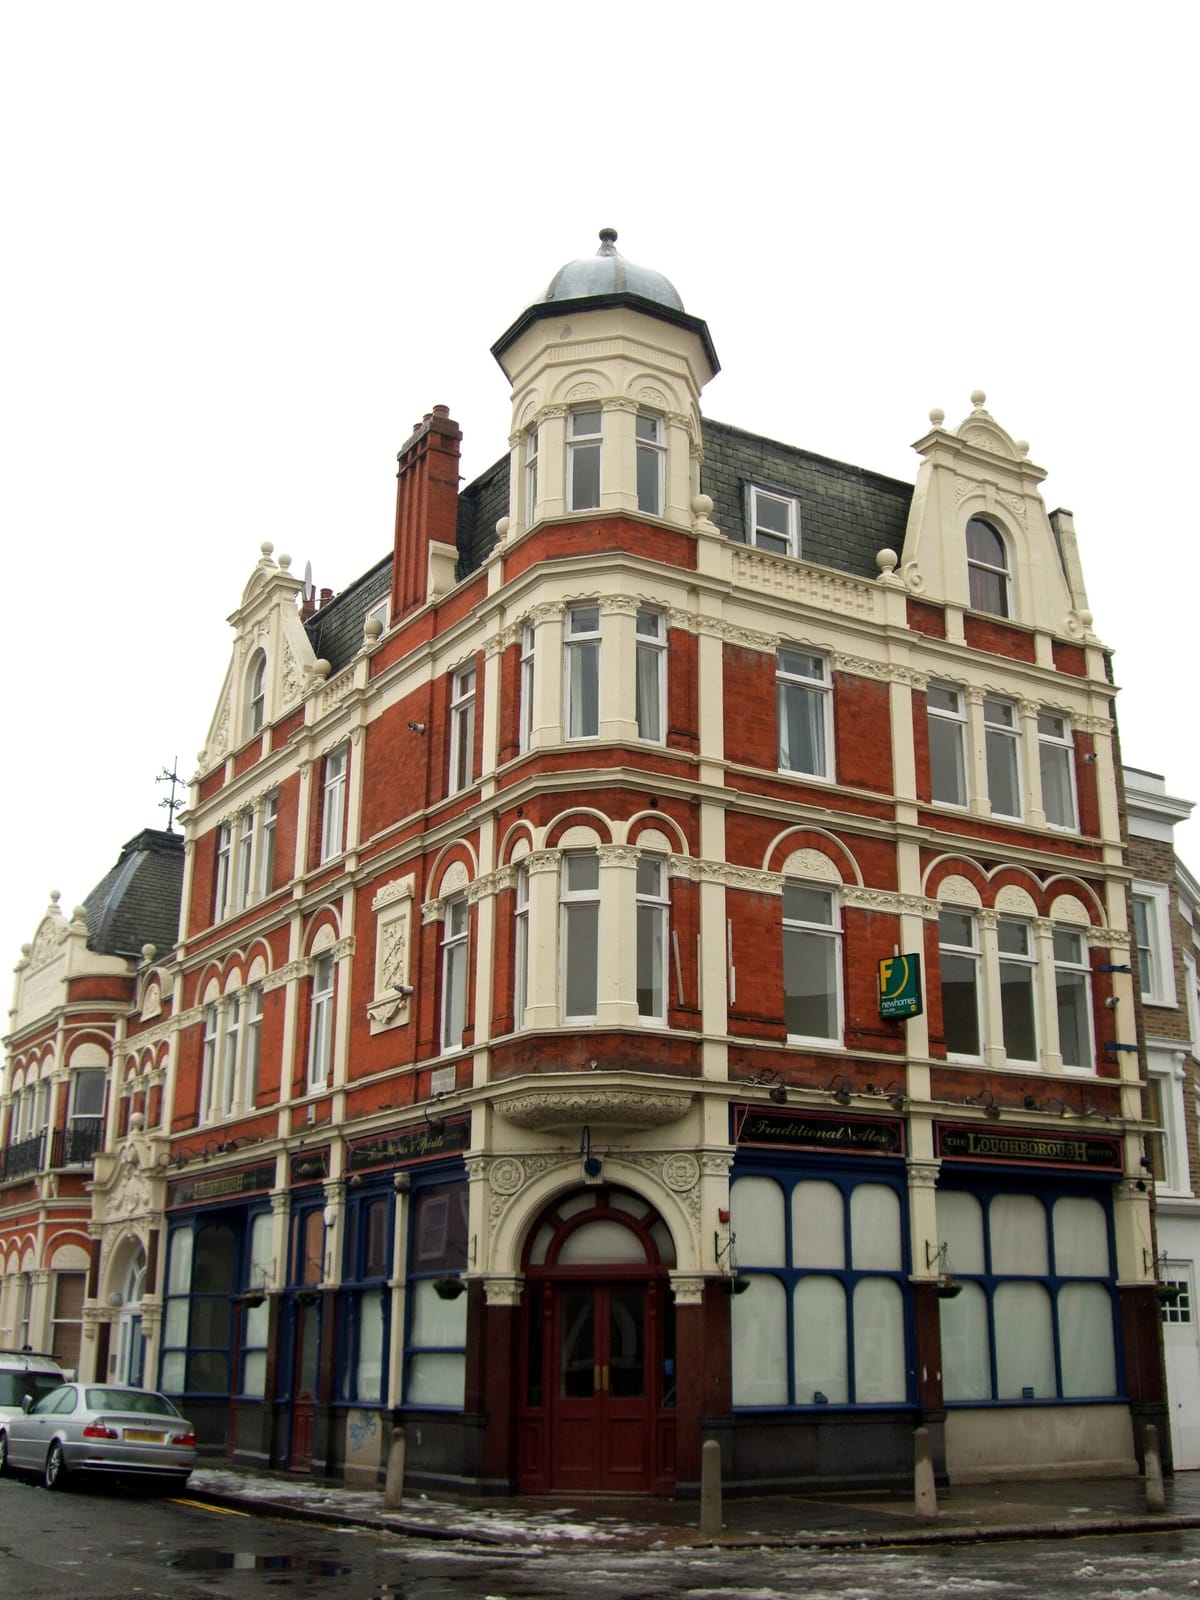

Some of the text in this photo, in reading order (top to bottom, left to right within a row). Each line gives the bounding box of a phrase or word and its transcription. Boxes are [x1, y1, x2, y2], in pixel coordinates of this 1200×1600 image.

[880, 958, 894, 992] F
[881, 997, 916, 1009] newhomes
[752, 1119, 888, 1144] Traditional Ales
[946, 1137, 966, 1147] THE
[967, 1132, 1088, 1162] LOUGHBOROUGH
